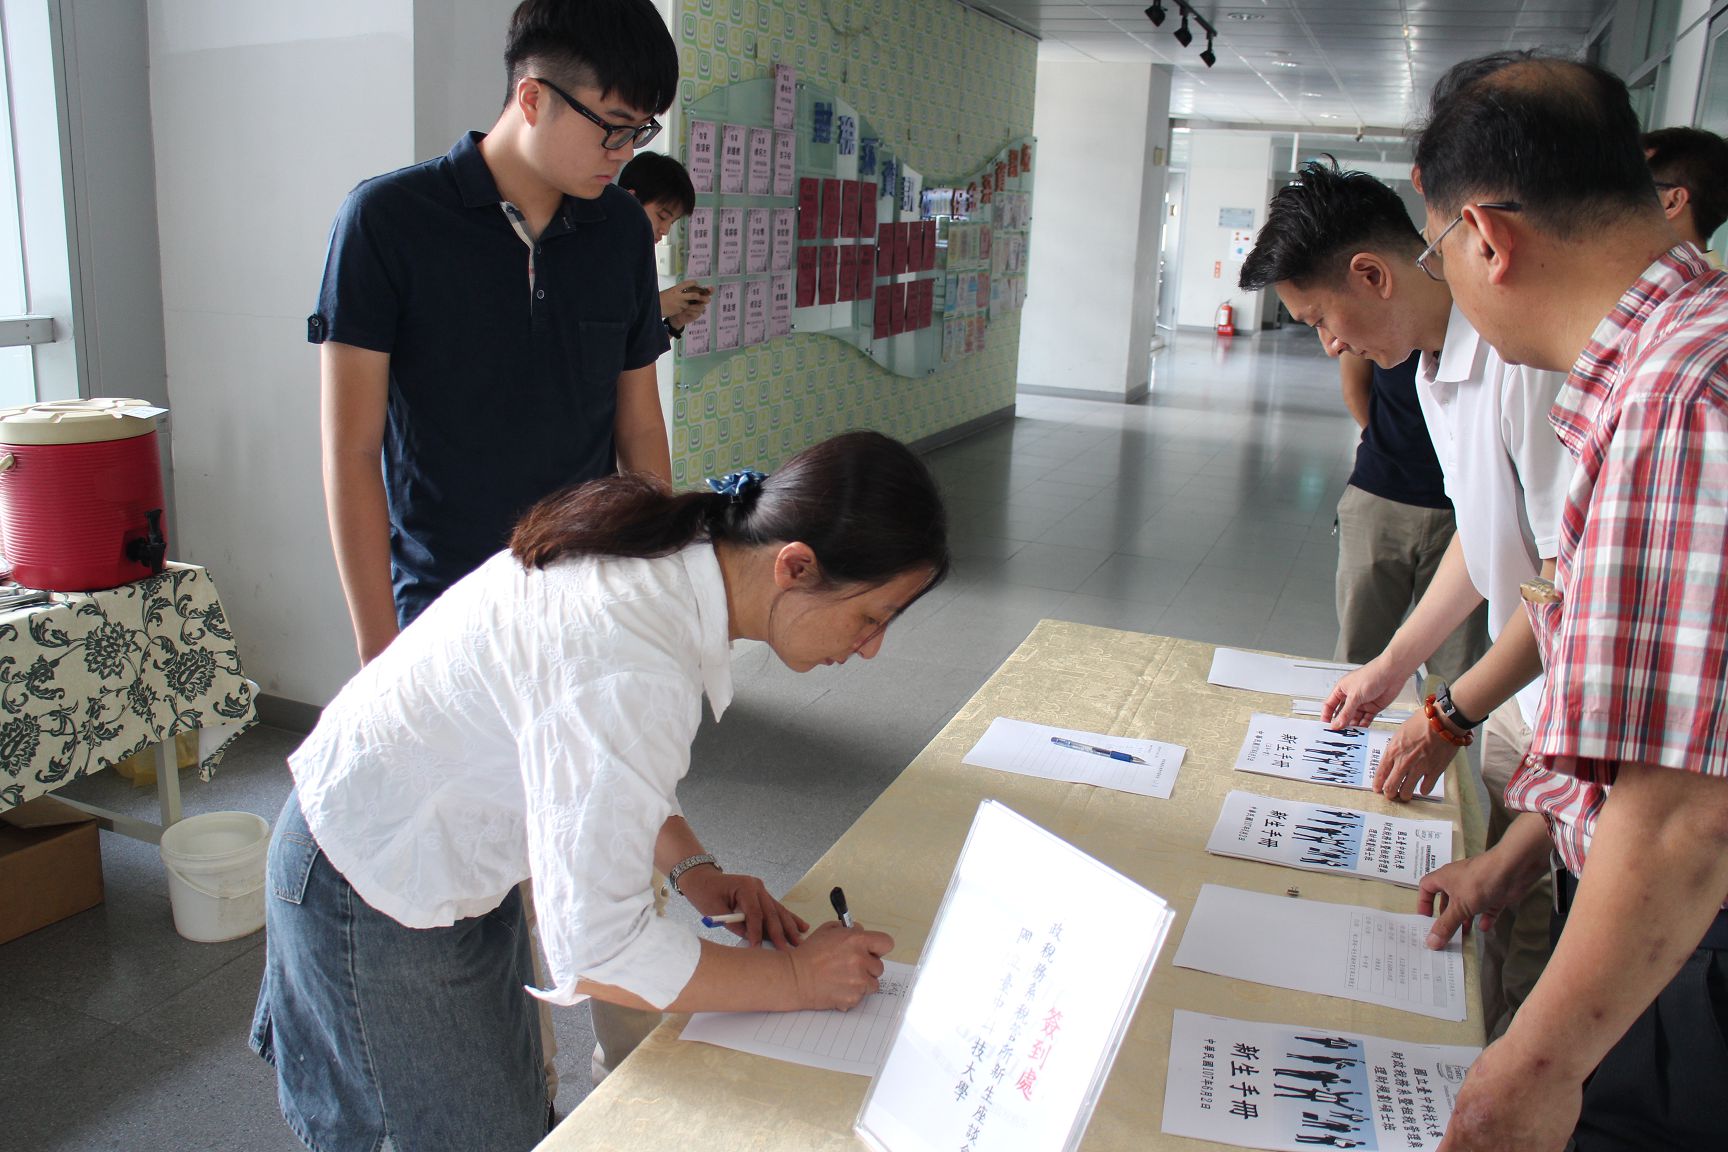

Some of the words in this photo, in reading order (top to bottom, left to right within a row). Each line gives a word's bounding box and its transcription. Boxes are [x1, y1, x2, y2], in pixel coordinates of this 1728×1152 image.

[1271, 733, 1298, 768] 新生手冊
[1258, 809, 1290, 848] 新生手冊
[1015, 1006, 1064, 1102] 簽到處
[1199, 1038, 1217, 1111] 中華民國107年6月2日
[1228, 1041, 1261, 1120] 新生手冊
[1374, 1065, 1397, 1132] 理財規劃碩士班
[1391, 1051, 1424, 1149] 財政稅務系暨租稅管理與
[1413, 1067, 1444, 1137] 國立臺中科技大學
